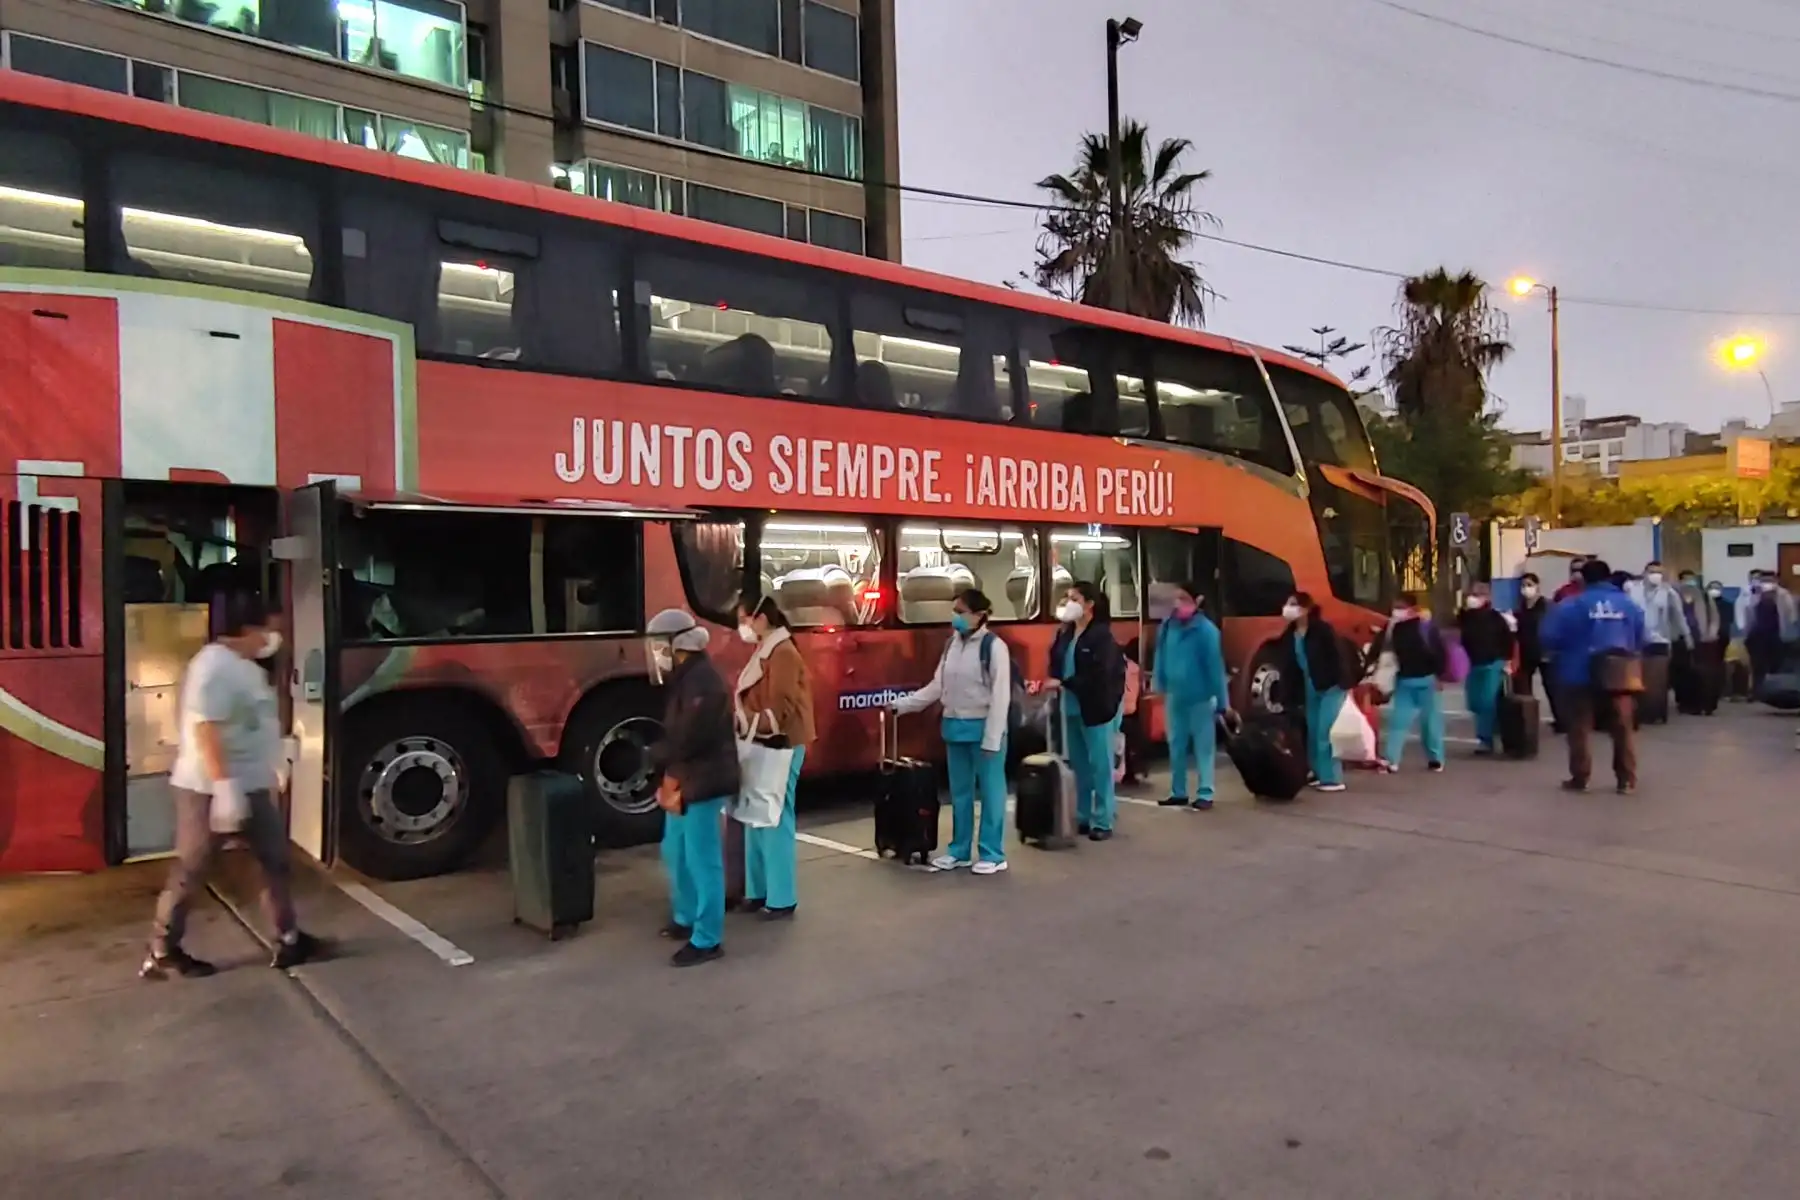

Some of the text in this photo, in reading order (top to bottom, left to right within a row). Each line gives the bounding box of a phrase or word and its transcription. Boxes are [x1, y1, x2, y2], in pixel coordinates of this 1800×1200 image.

[555, 417, 1174, 516] JUNTOS SIEMPRE. ¡ARRIBA PERÚ!
